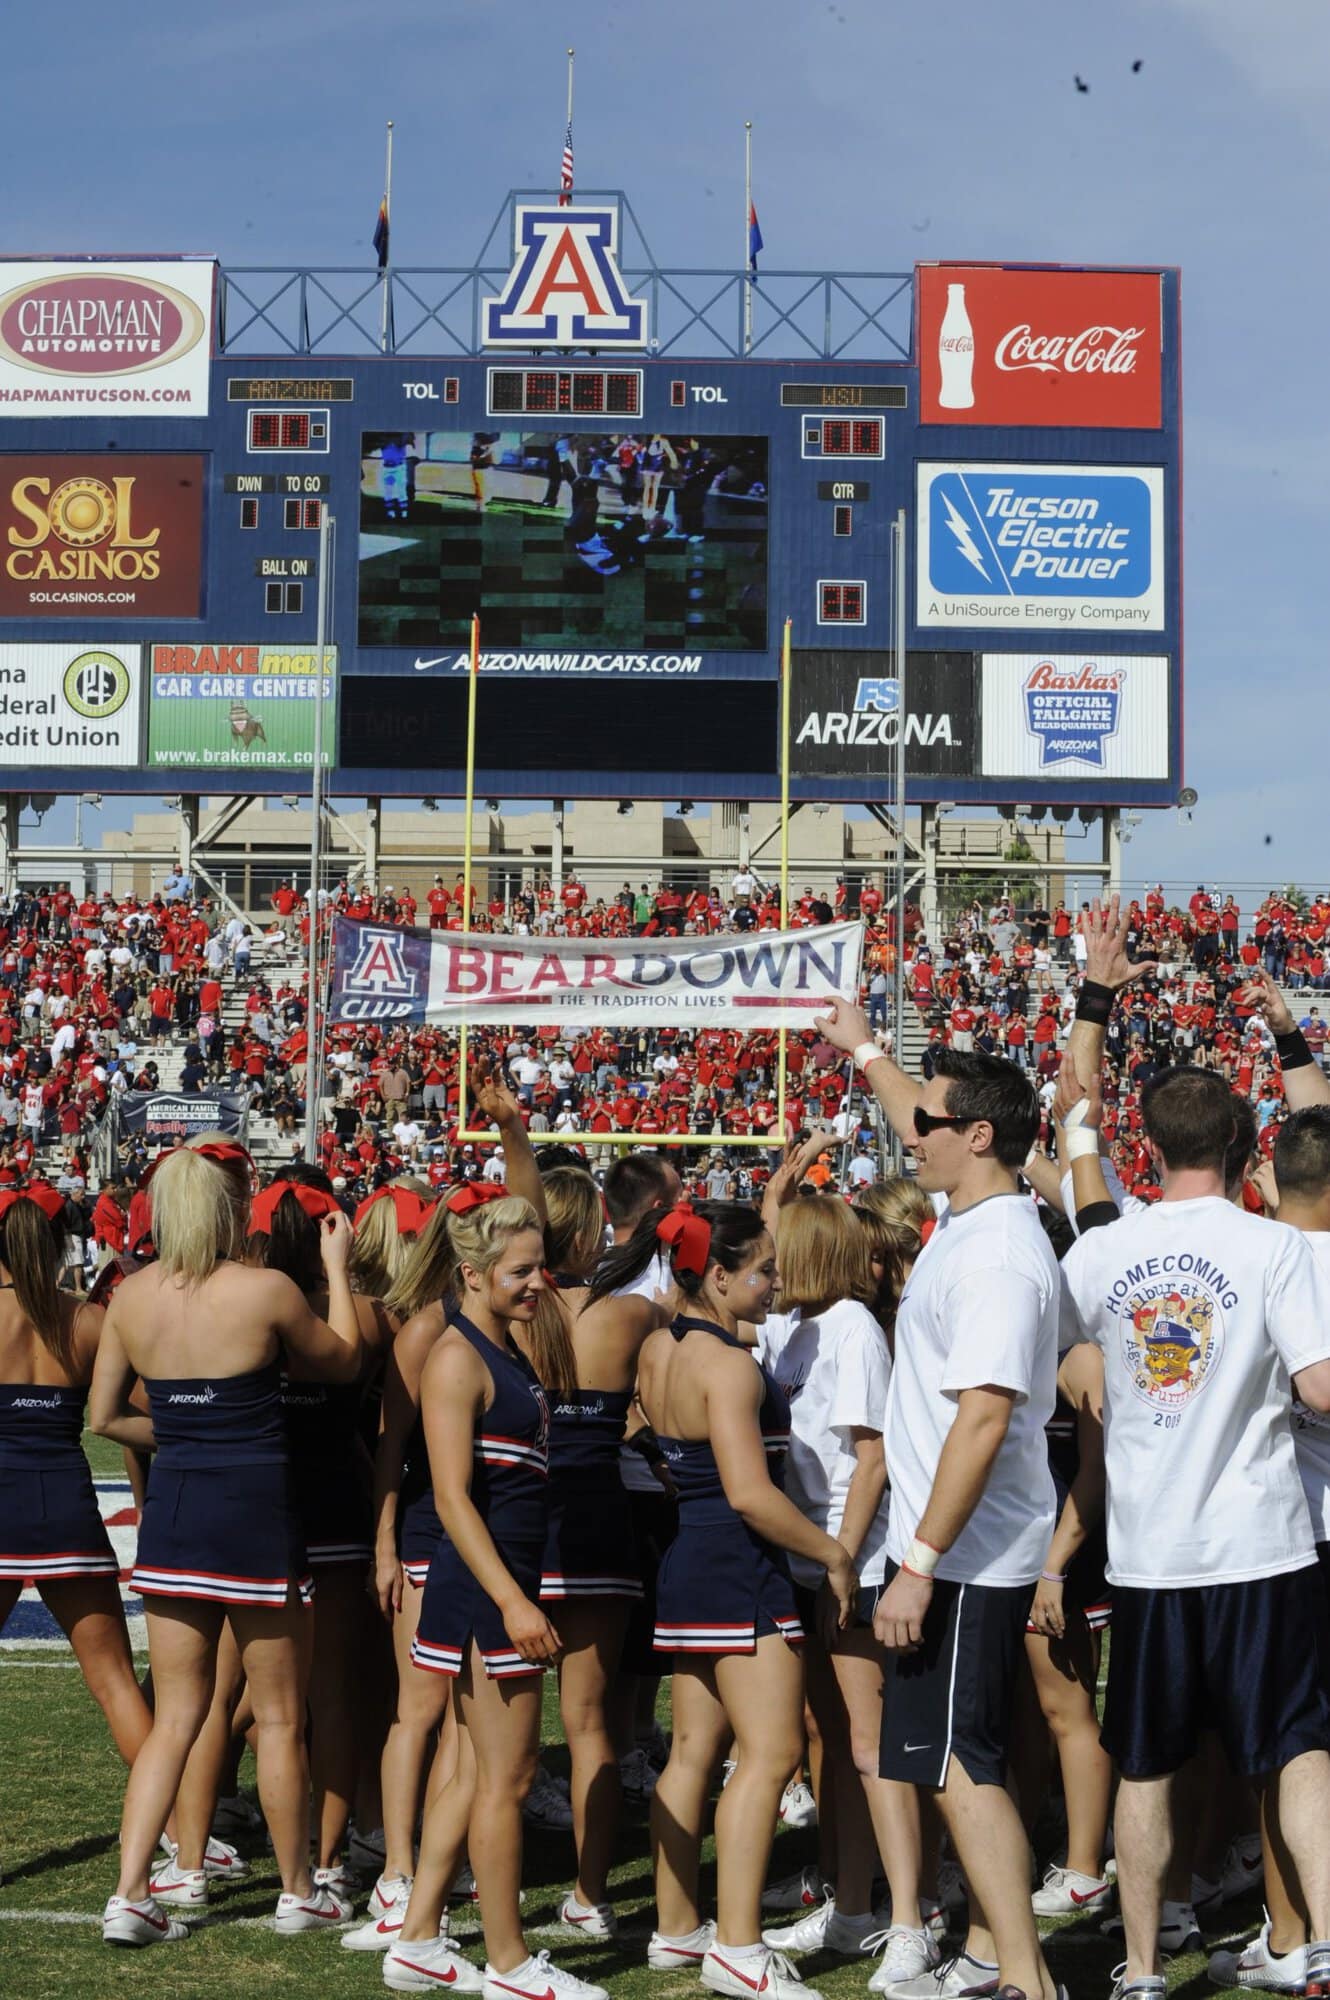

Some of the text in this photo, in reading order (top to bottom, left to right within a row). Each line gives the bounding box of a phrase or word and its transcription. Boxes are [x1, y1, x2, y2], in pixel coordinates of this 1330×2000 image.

[482, 206, 648, 347] A
[18, 300, 165, 338] CHAPMAN
[22, 339, 161, 353] AUTOMOTIVE
[994, 323, 1145, 374] Coca-Cola
[248, 381, 332, 399] ARIZONA
[403, 383, 440, 400] TOL
[691, 386, 728, 403] TOL
[237, 478, 262, 492] DWN
[287, 477, 321, 492] TO GO
[832, 483, 854, 499] QTR
[7, 476, 161, 548] SOL
[985, 488, 1099, 520] Tucson
[997, 519, 1130, 550] Electric
[6, 550, 161, 580] CASINOS
[262, 559, 308, 576] BALL ON
[1010, 549, 1129, 580] Power
[29, 592, 136, 604] SOLCASINOS.COM
[928, 604, 1150, 622] A UniSource Energy Company
[154, 646, 334, 674] BRAKE max
[156, 679, 330, 698] CAR CARE CENTERS
[854, 678, 899, 712] FS
[1033, 695, 1112, 708] OFFICIAL
[1033, 709, 1112, 721] TAILGATE
[796, 712, 952, 746] ARIZONA
[1033, 721, 1112, 731] HEADQUARTERS
[47, 726, 120, 746] Union
[1046, 739, 1098, 750] ARIZONA
[342, 926, 415, 997] A
[558, 994, 726, 1007] THE TRADITION LIVES
[1106, 1253, 1239, 1314] HOMECOMING
[1122, 1282, 1176, 1320] Wilbur
[1180, 1283, 1199, 1300] at
[11, 1398, 55, 1408] ARIZONA
[168, 1394, 210, 1404] ARIZONA
[554, 1405, 598, 1415] ARIZONA
